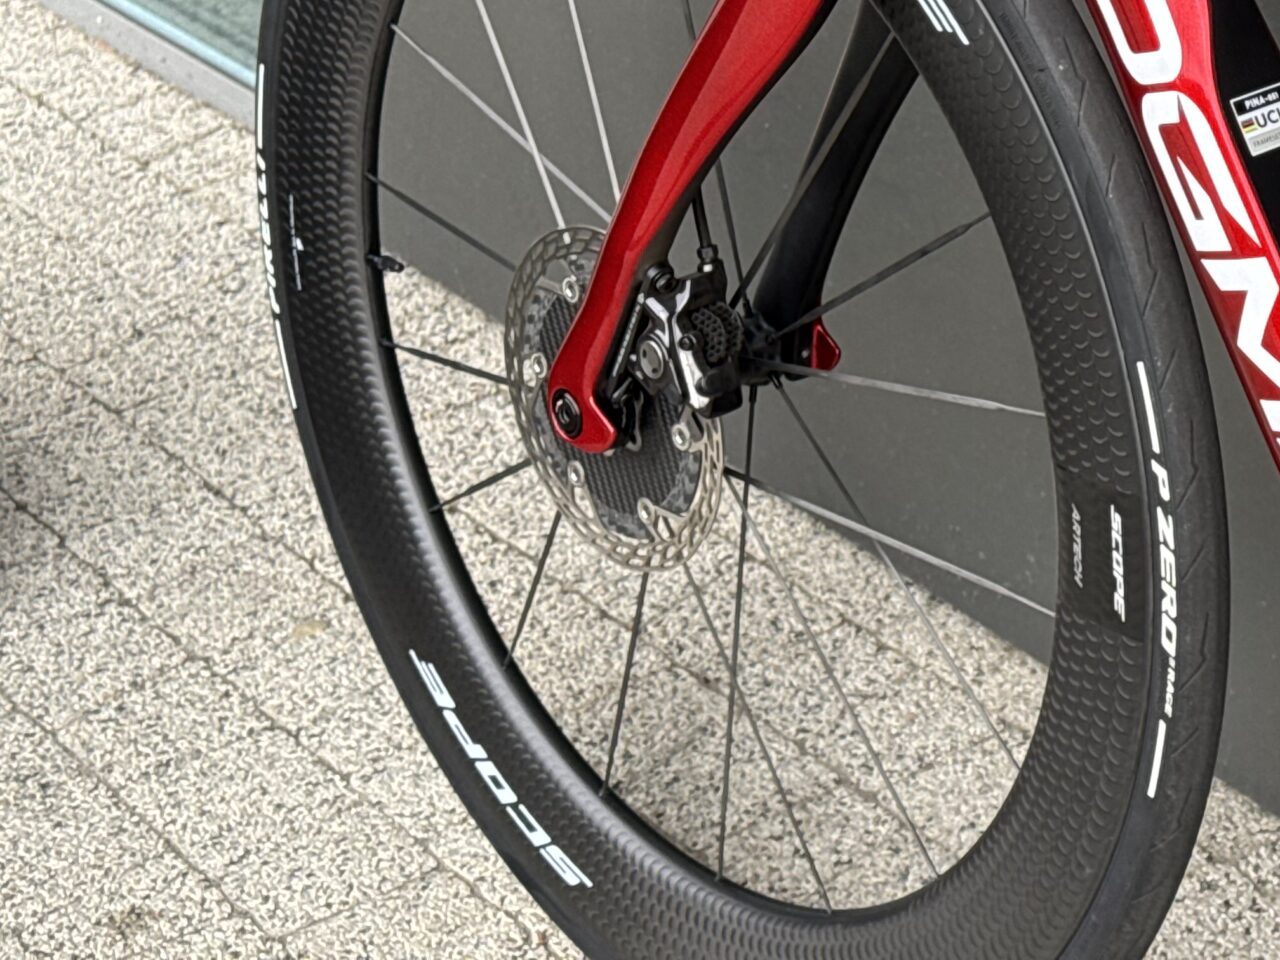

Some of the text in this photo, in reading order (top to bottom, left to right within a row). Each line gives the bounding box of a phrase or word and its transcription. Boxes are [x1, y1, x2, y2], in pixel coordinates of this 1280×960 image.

[1151, 458, 1171, 503] P
[1071, 503, 1084, 588] ARTECH
[1110, 504, 1126, 622] SCOPE
[1156, 506, 1178, 658] ZERO
[408, 649, 594, 888] SCOPE
